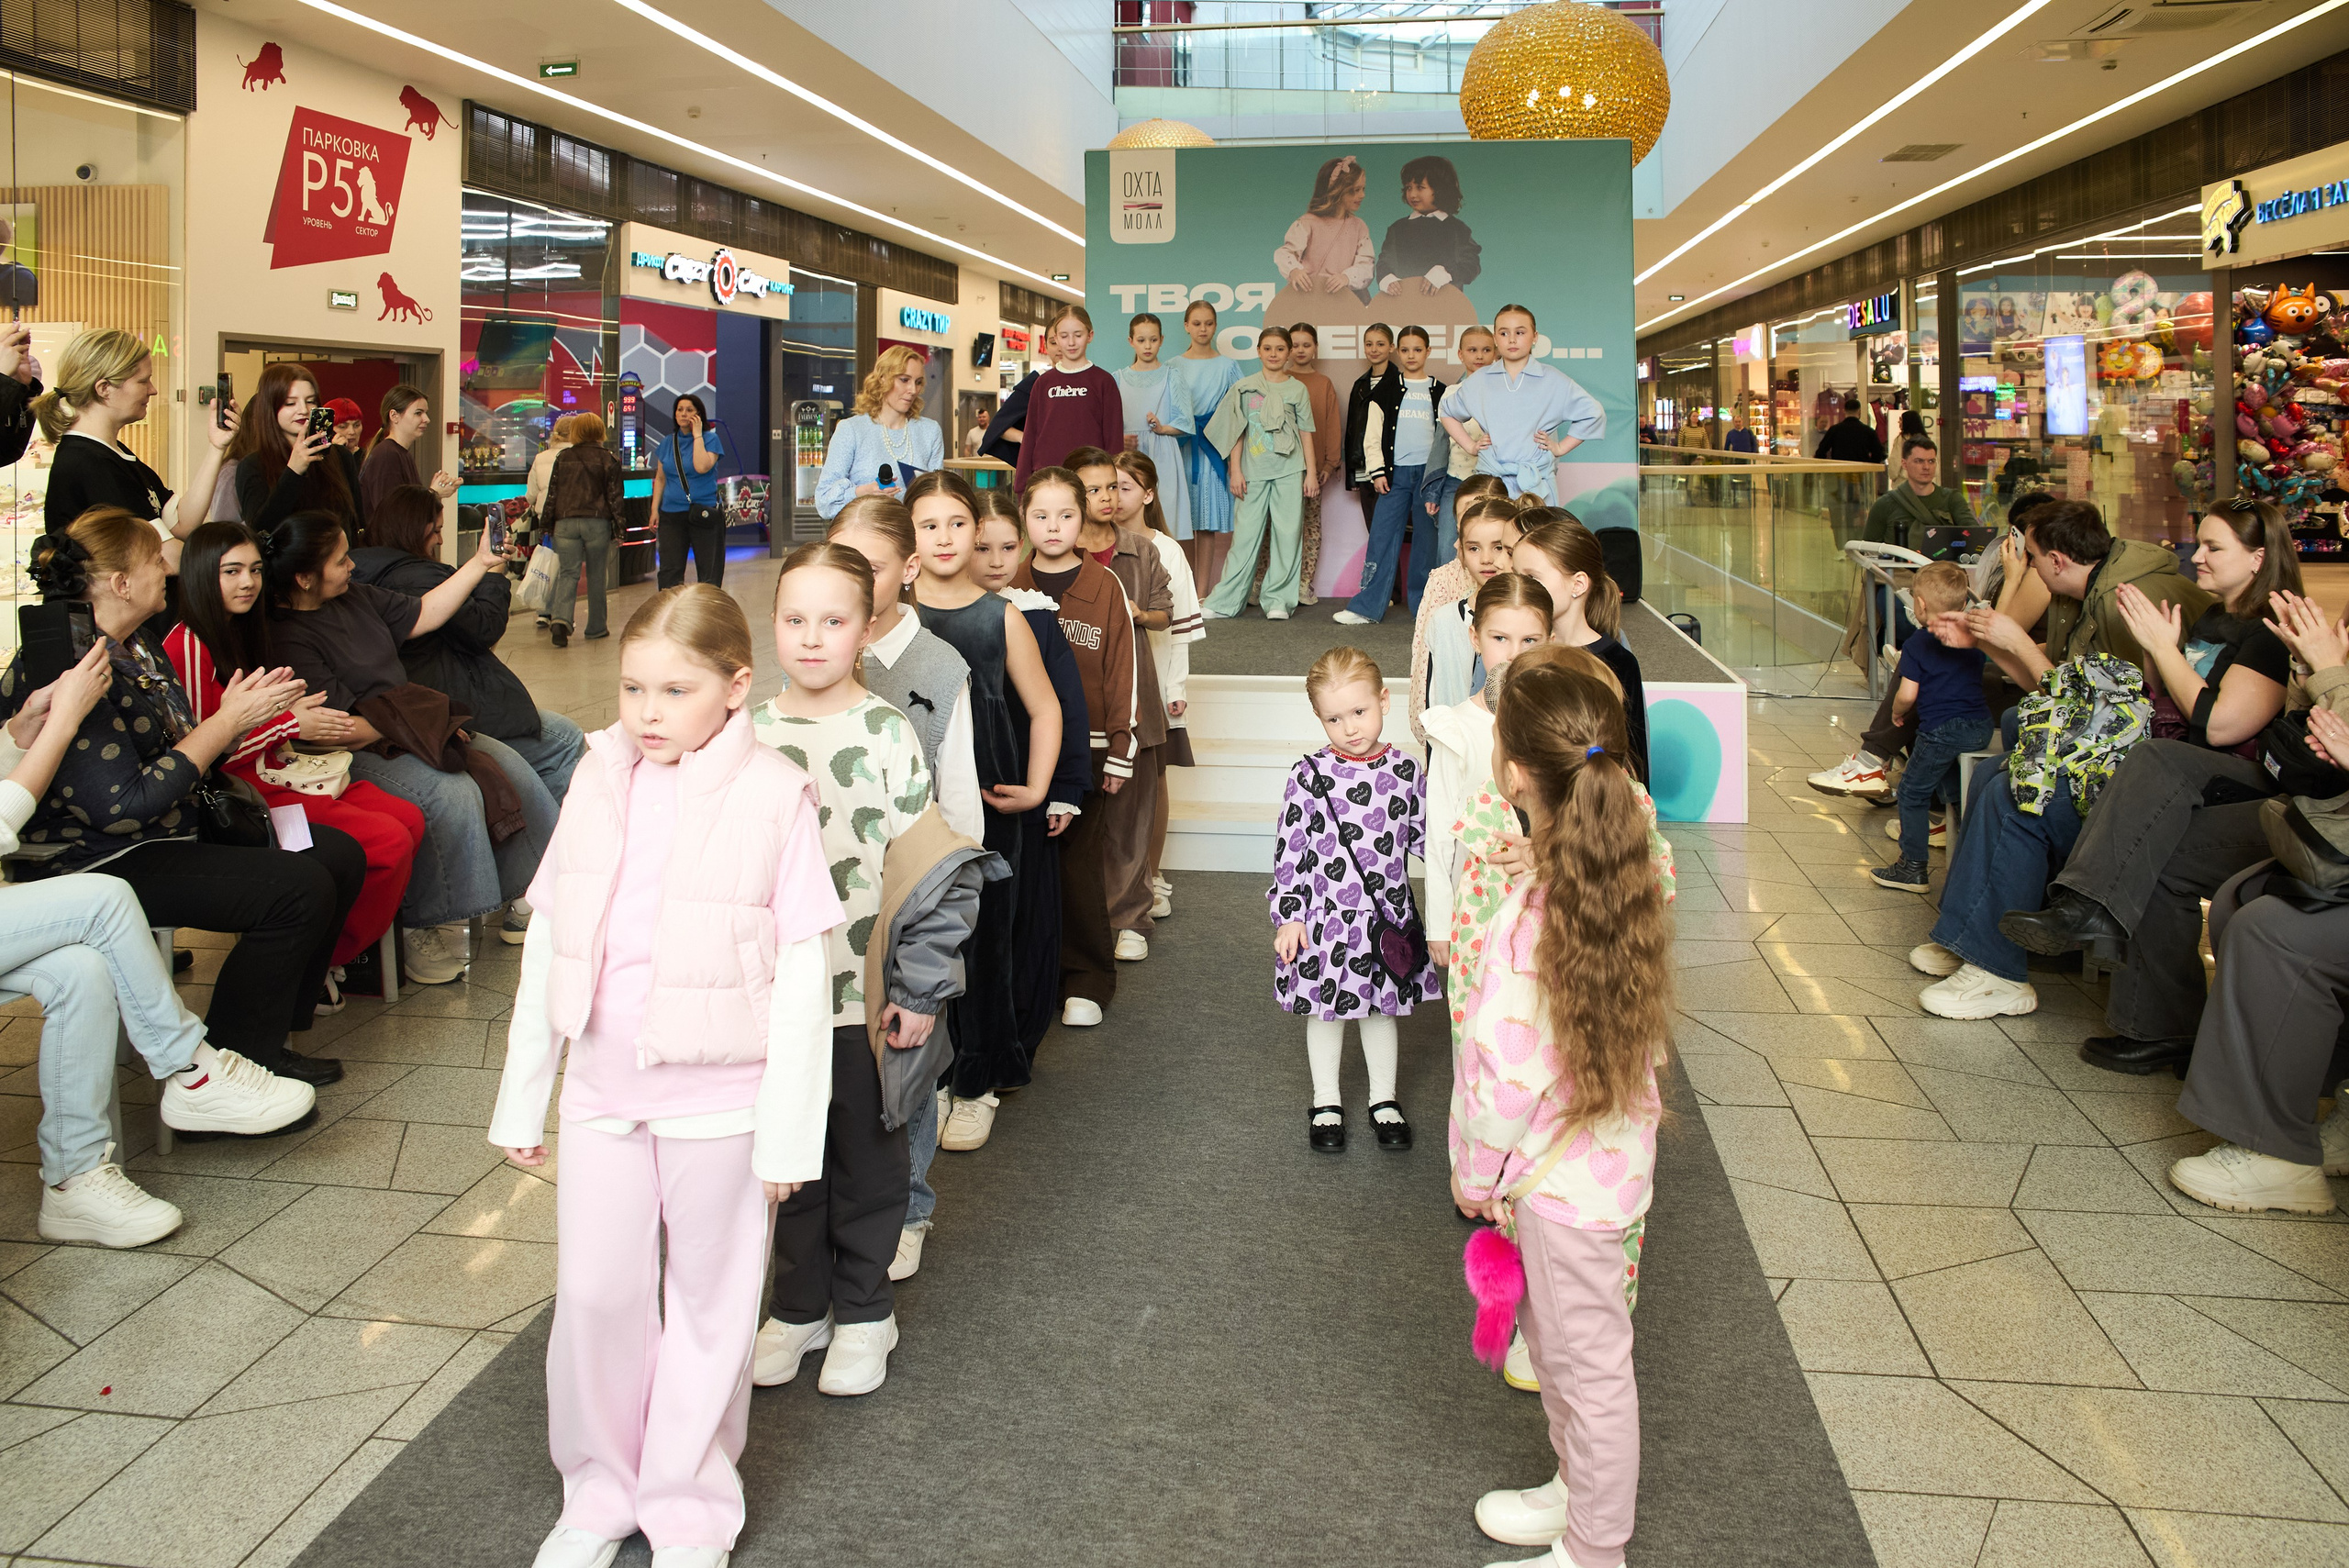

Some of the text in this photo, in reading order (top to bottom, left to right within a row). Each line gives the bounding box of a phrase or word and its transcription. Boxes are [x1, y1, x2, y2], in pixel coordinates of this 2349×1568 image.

[303, 127, 380, 163] ПАРКОВКА
[1123, 171, 1163, 198] ОХТА
[2255, 186, 2321, 225] ВЕСЁЛАЯ
[303, 217, 333, 229] УРОВЕНЬ
[355, 226, 379, 238] СЕКТОР
[1123, 213, 1163, 230] МОЛЛ
[636, 251, 665, 270] ДРИФТ
[769, 281, 796, 295] КАРТИНГ
[1109, 283, 1275, 314] ТВОЯ
[904, 306, 952, 335] CRAZY ТИР
[1847, 294, 1890, 330] DESALU
[1048, 384, 1088, 399] Chère
